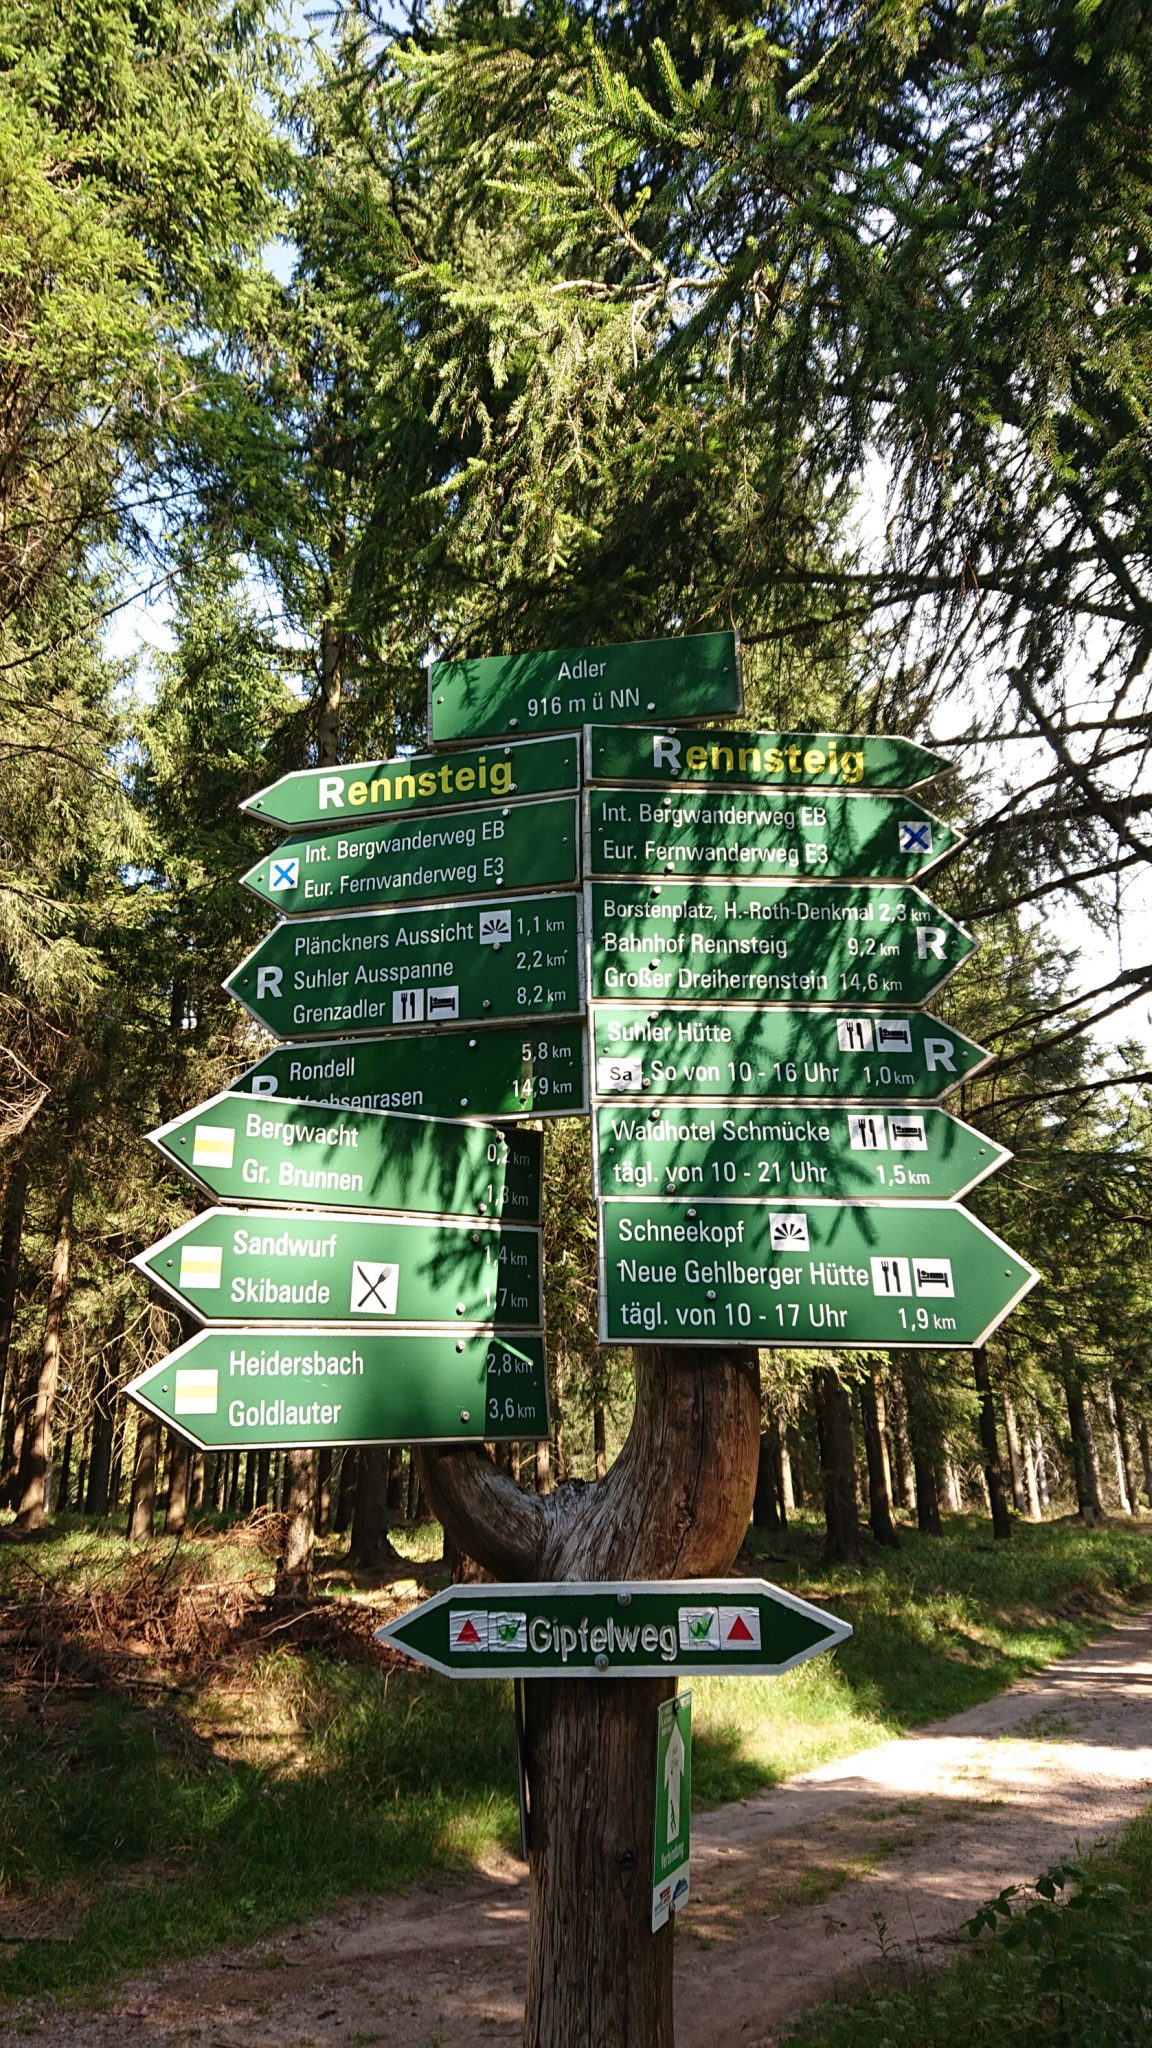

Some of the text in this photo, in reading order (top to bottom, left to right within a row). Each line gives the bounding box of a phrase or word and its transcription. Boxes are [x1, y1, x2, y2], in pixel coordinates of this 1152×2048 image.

[558, 661, 607, 681] Adler
[528, 687, 640, 717] 916 m ü NN
[653, 735, 865, 782] Rennsteig
[318, 756, 513, 811] Rennsteig
[602, 802, 827, 830] Int. Bergwanderweg EB
[305, 820, 505, 863] Int. Bergwanderweg EB
[603, 840, 829, 867] Eur. Fernwanderweg E3
[304, 857, 505, 899] Eur. Fernwanderweg E3
[604, 899, 931, 925] Borstenplatz, H.-Roth-Denkmal 2,3 km
[295, 915, 565, 957] Plänckners Aussicht 1,1 km
[605, 932, 900, 959] Bahnhof Rennsteig 9,2 km
[916, 926, 947, 960] R
[256, 965, 284, 1000] R
[293, 950, 566, 991] Suhler Ausspanne 2,2 km
[604, 967, 902, 994] Großer Dreiherrenstein 14,6 km
[293, 985, 566, 1025] Grenzadler 8,2 km
[608, 1020, 732, 1042] Suhler Hütte
[290, 1042, 571, 1082] Rondell 5,8 km
[923, 1038, 957, 1072] R
[513, 1077, 549, 1098] 14,9
[553, 1081, 572, 1094] km
[610, 1067, 632, 1081] Sa
[651, 1060, 677, 1082] So
[683, 1065, 720, 1082] von
[727, 1062, 752, 1082] 10
[773, 1062, 797, 1083] 16
[804, 1063, 840, 1084] Uhr
[863, 1065, 892, 1087] 1,0
[893, 1070, 915, 1086] km
[245, 1112, 530, 1166] Bergwacht 0,2 km
[611, 1119, 831, 1143] Waldhotel Schmücke
[242, 1158, 529, 1206] Gr. Brunnen 1,8 km
[613, 1161, 659, 1188] tägl.
[666, 1166, 703, 1183] von
[712, 1162, 737, 1183] 10
[757, 1161, 781, 1182] 21
[791, 1161, 827, 1183] Uhr
[876, 1164, 907, 1187] 1,5
[907, 1169, 931, 1185] km
[232, 1228, 528, 1269] Sandwurf 1,4 km
[618, 1218, 745, 1248] Schneekopf
[619, 1260, 870, 1291] Neue Gehlberger Hütte
[230, 1276, 528, 1311] Skibaude 1,7 km
[620, 1303, 669, 1331] tägl.
[676, 1308, 716, 1327] von
[725, 1303, 752, 1328] 10
[775, 1303, 801, 1328] 17
[809, 1303, 848, 1328] Uhr
[898, 1307, 929, 1331] 1,9
[933, 1314, 957, 1331] km
[230, 1350, 533, 1376] Heidersbach 2,8 km
[228, 1398, 536, 1427] Goldlauter 3,6 km
[528, 1616, 678, 1663] Gipfelweg
